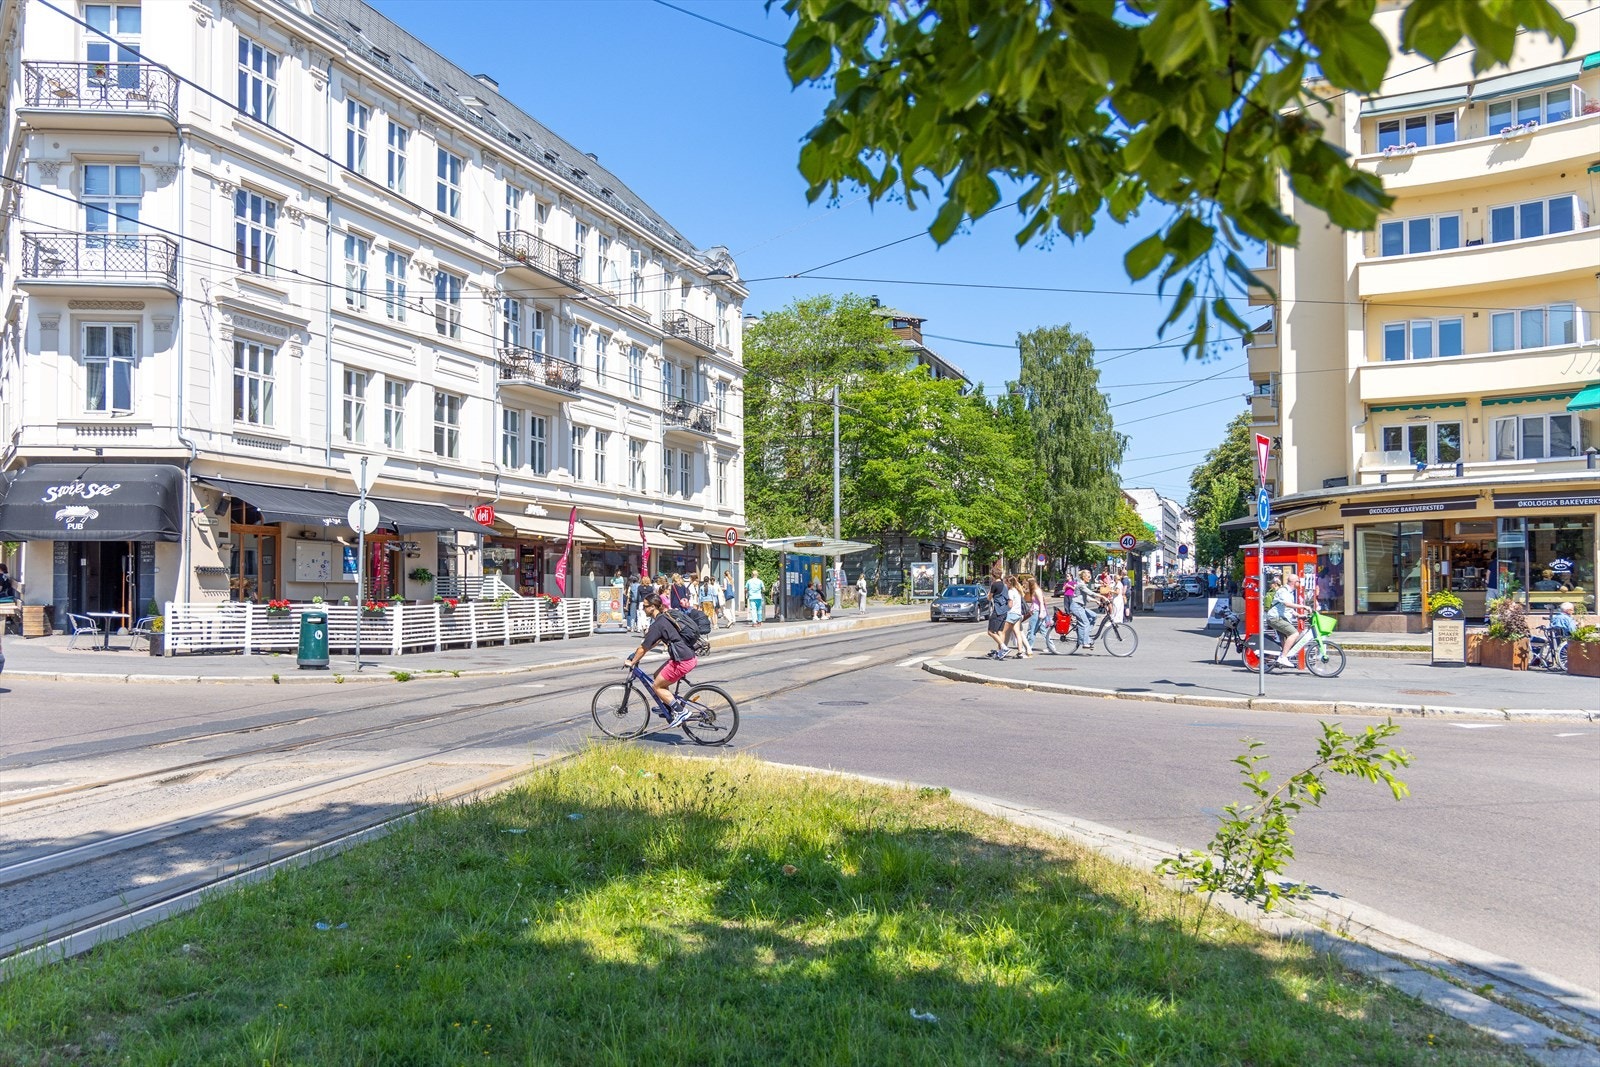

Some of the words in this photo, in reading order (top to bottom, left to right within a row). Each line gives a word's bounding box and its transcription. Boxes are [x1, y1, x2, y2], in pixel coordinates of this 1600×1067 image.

[1369, 507, 1400, 515] ØKOLOGISK
[1400, 504, 1445, 513] BAKEVERKSTED
[477, 509, 489, 522] deli
[728, 531, 736, 542] 40
[1122, 537, 1134, 546] 40
